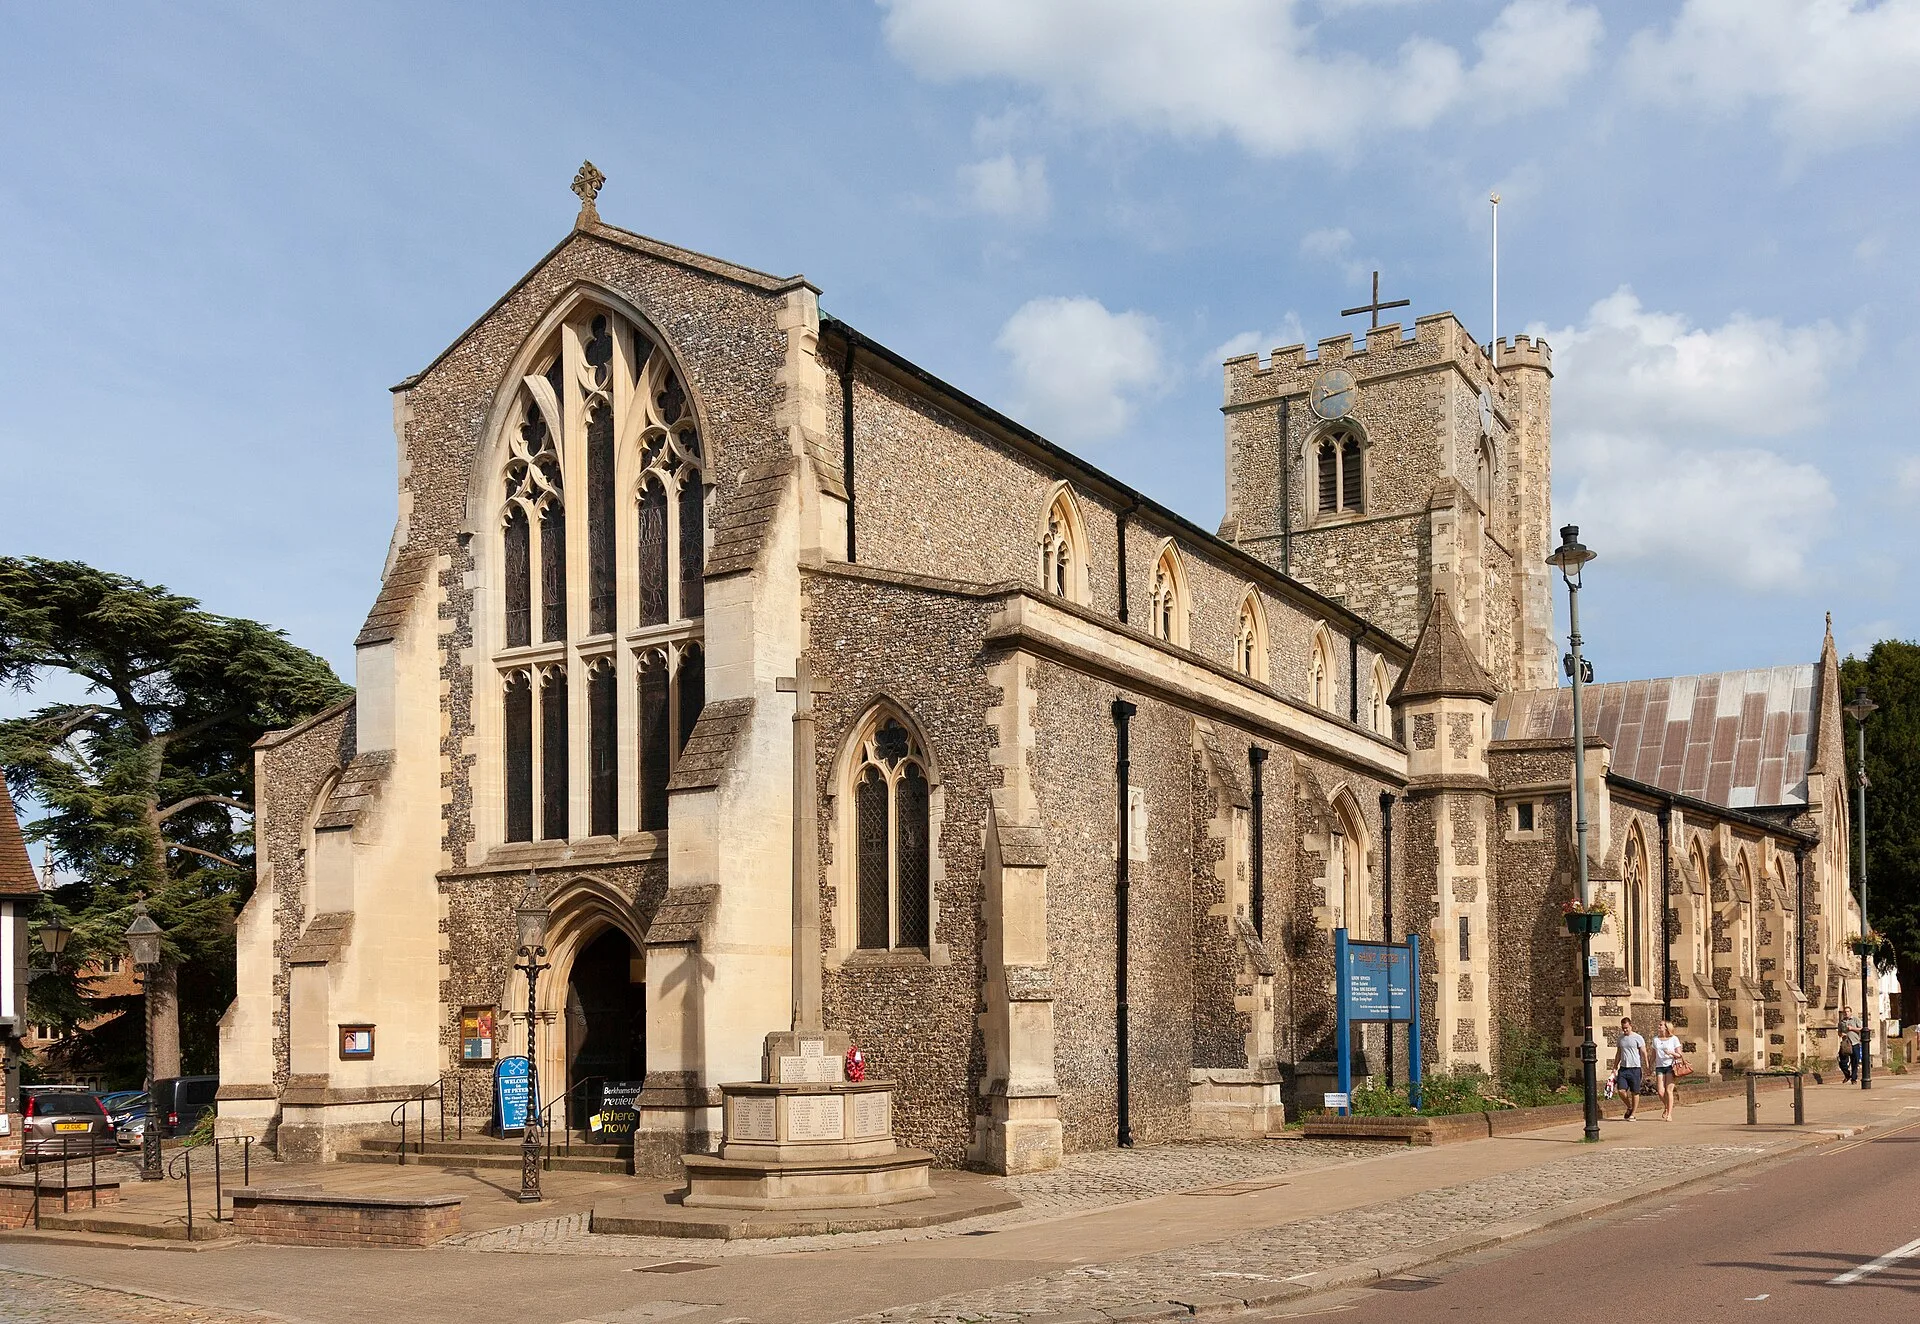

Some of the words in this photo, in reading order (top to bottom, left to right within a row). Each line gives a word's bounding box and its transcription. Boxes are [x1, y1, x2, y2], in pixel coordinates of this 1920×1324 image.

[601, 1111, 610, 1122] is
[611, 1110, 635, 1121] here
[604, 1123, 630, 1133] now
